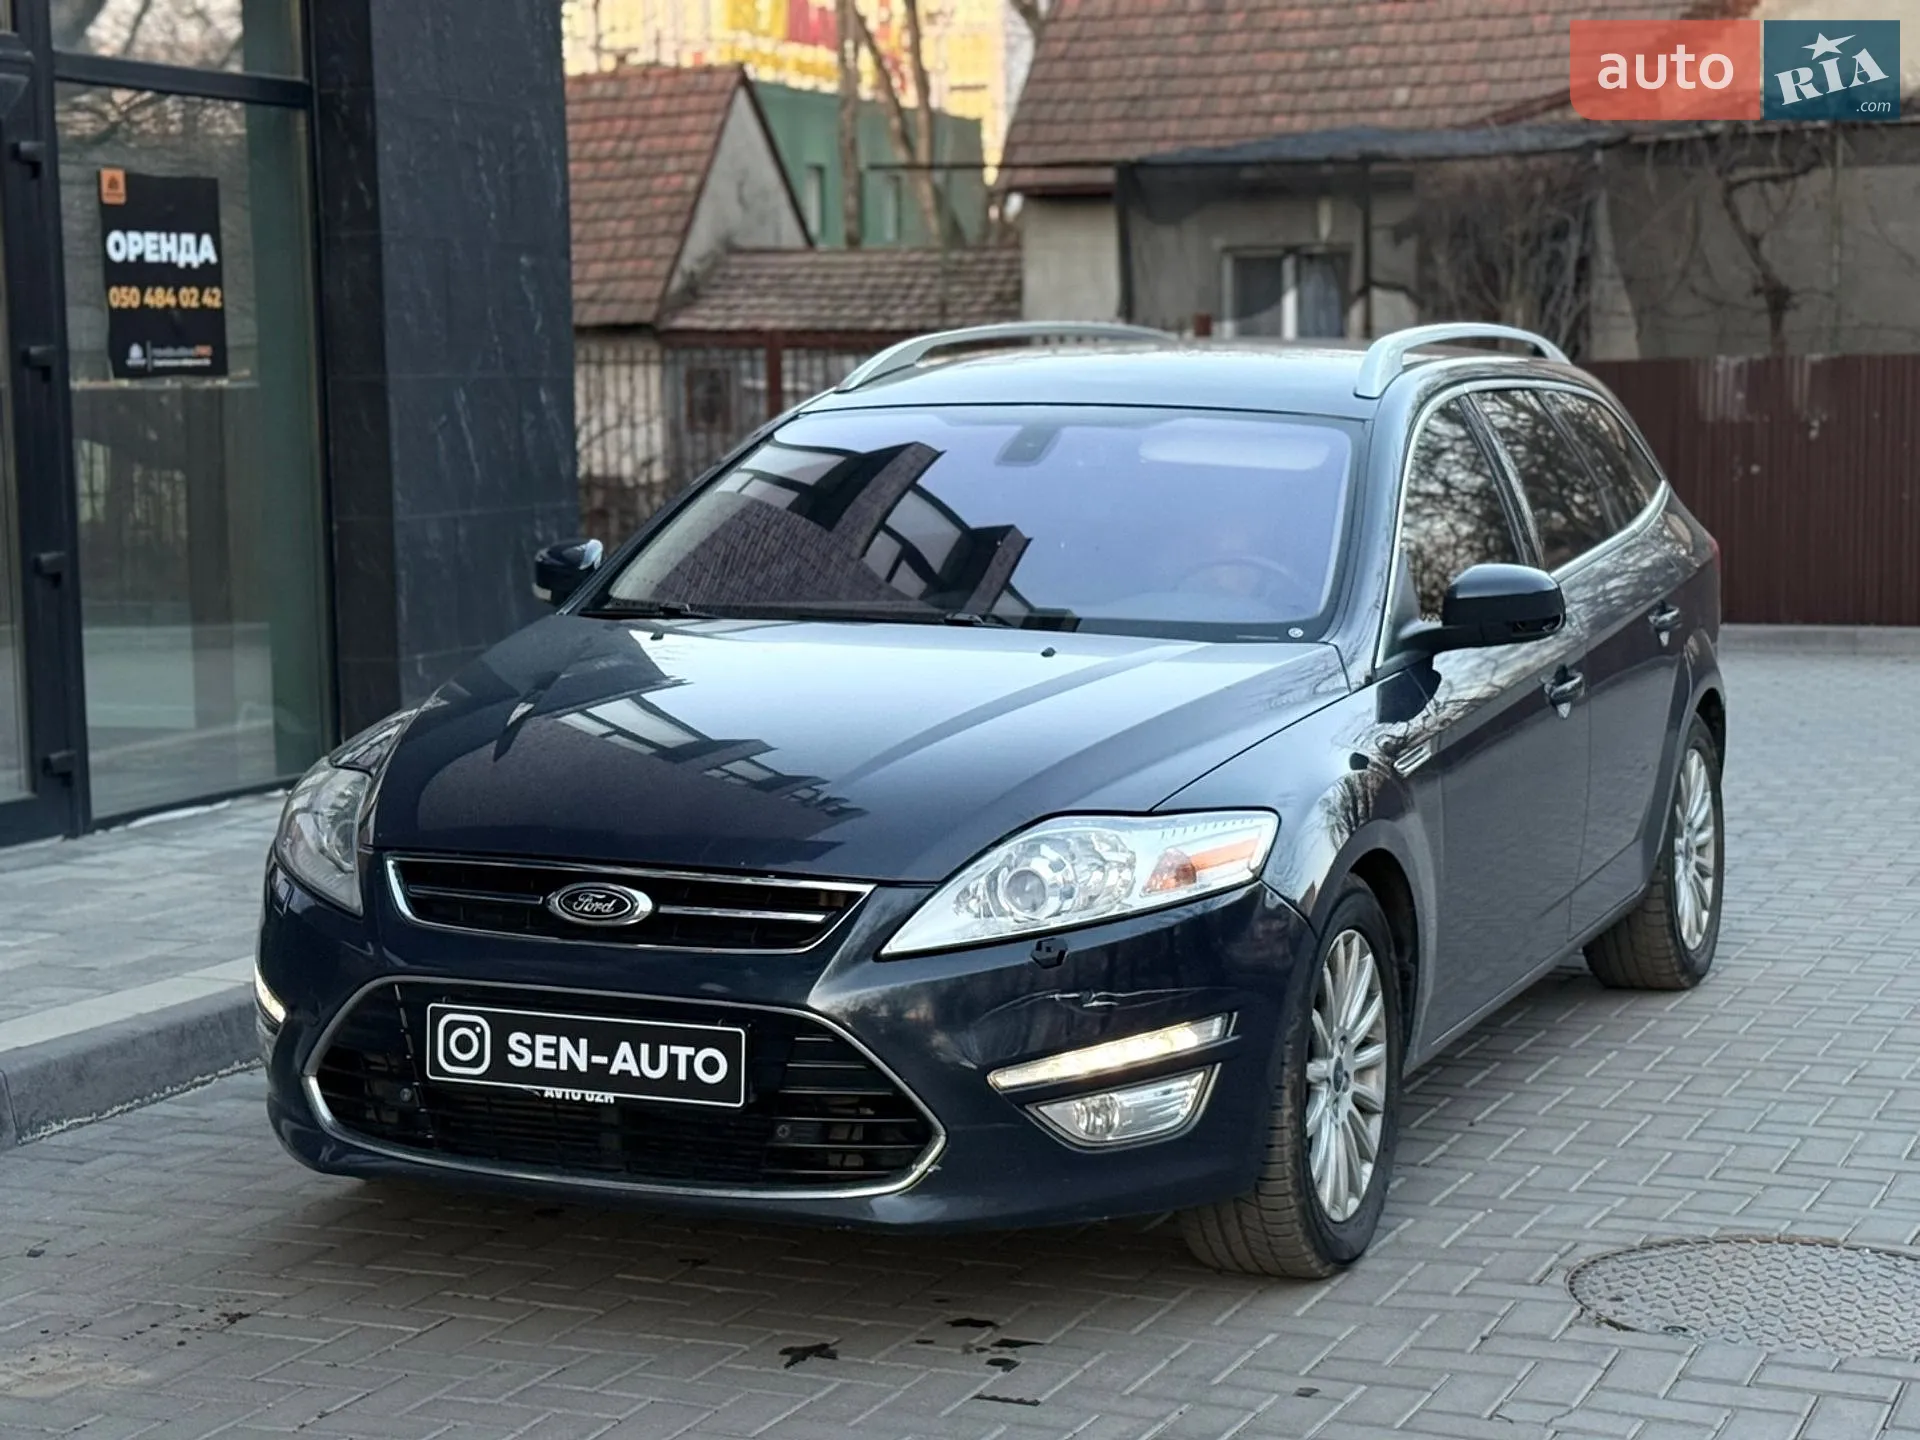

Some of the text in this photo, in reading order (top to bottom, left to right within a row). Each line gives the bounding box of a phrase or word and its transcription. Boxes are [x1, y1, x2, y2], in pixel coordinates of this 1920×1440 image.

[106, 230, 218, 268] ОРЕНДА
[109, 286, 222, 308] 050 484 02 42
[573, 893, 617, 912] Ford
[507, 1031, 728, 1084] SEN-AUTO
